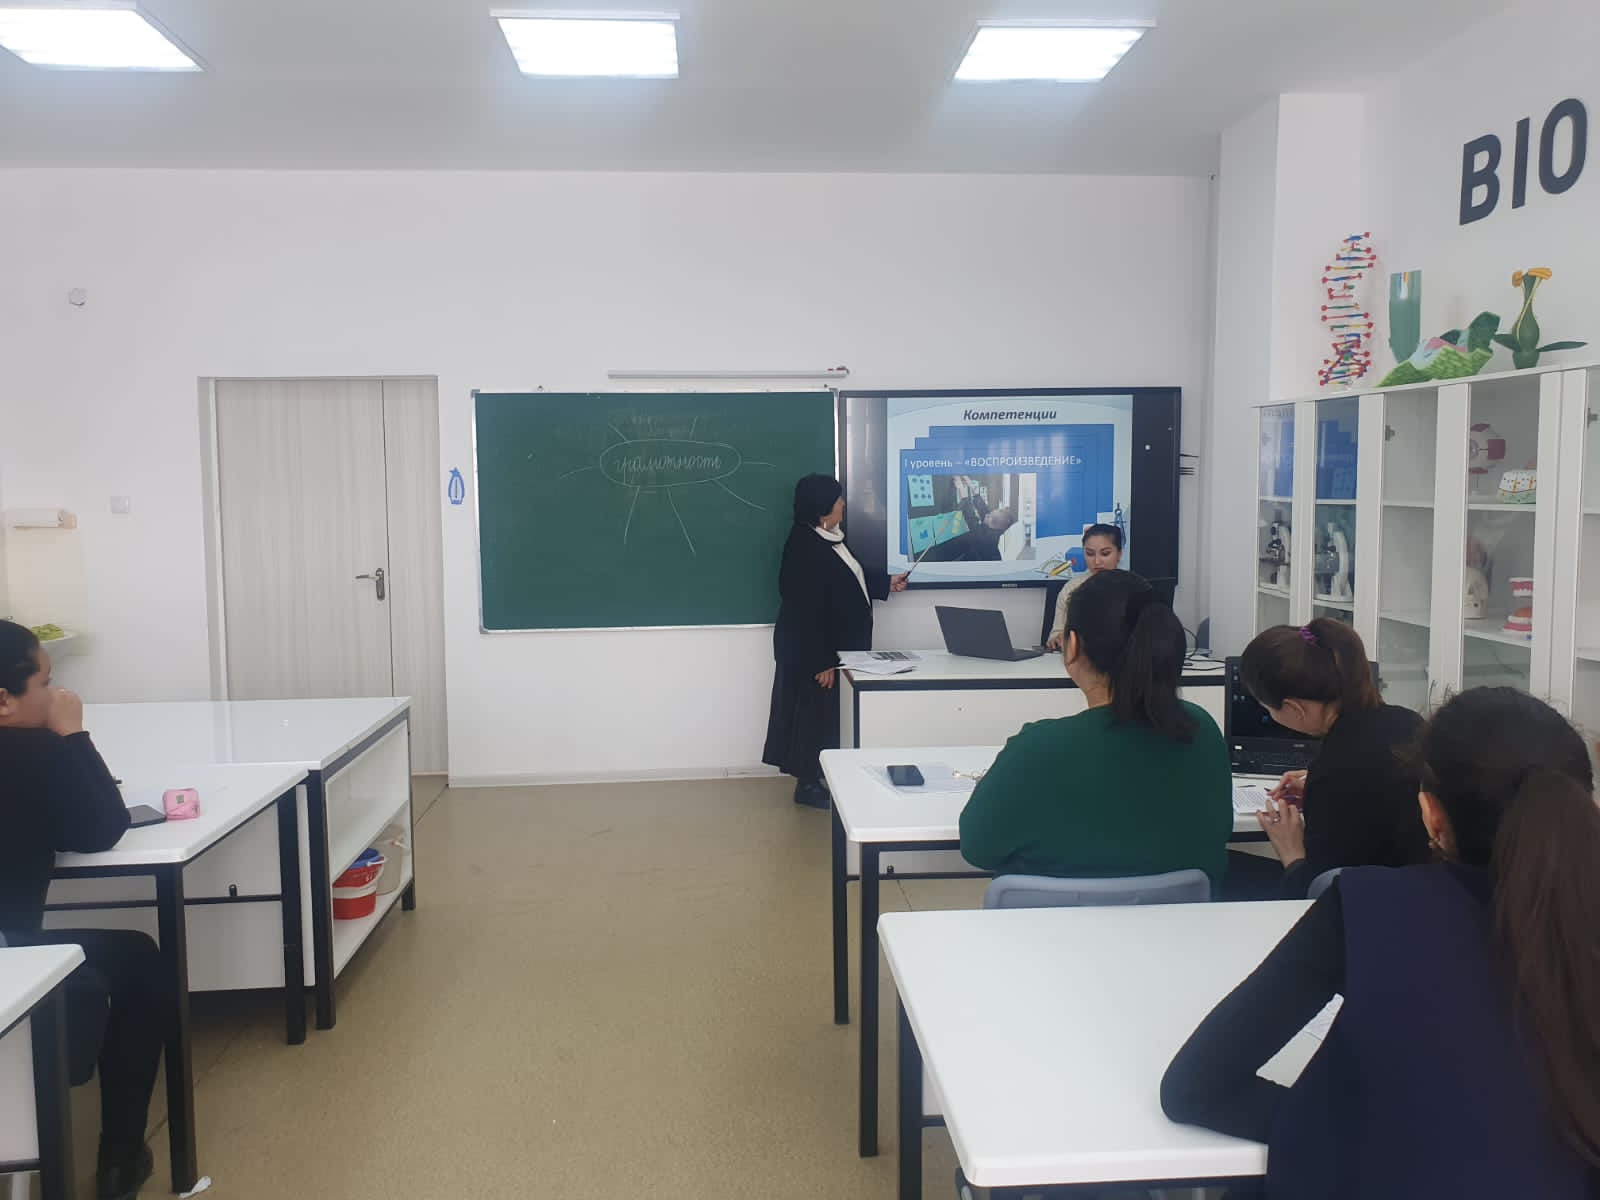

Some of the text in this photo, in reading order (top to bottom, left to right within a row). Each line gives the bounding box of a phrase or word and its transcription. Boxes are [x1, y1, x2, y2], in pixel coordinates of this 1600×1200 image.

[1459, 98, 1588, 226] BIO
[963, 409, 1057, 421] Компетенции
[910, 458, 953, 470] уровень
[965, 455, 1082, 468] «ВОСПРОИЗВЕДЕНИЕ»
